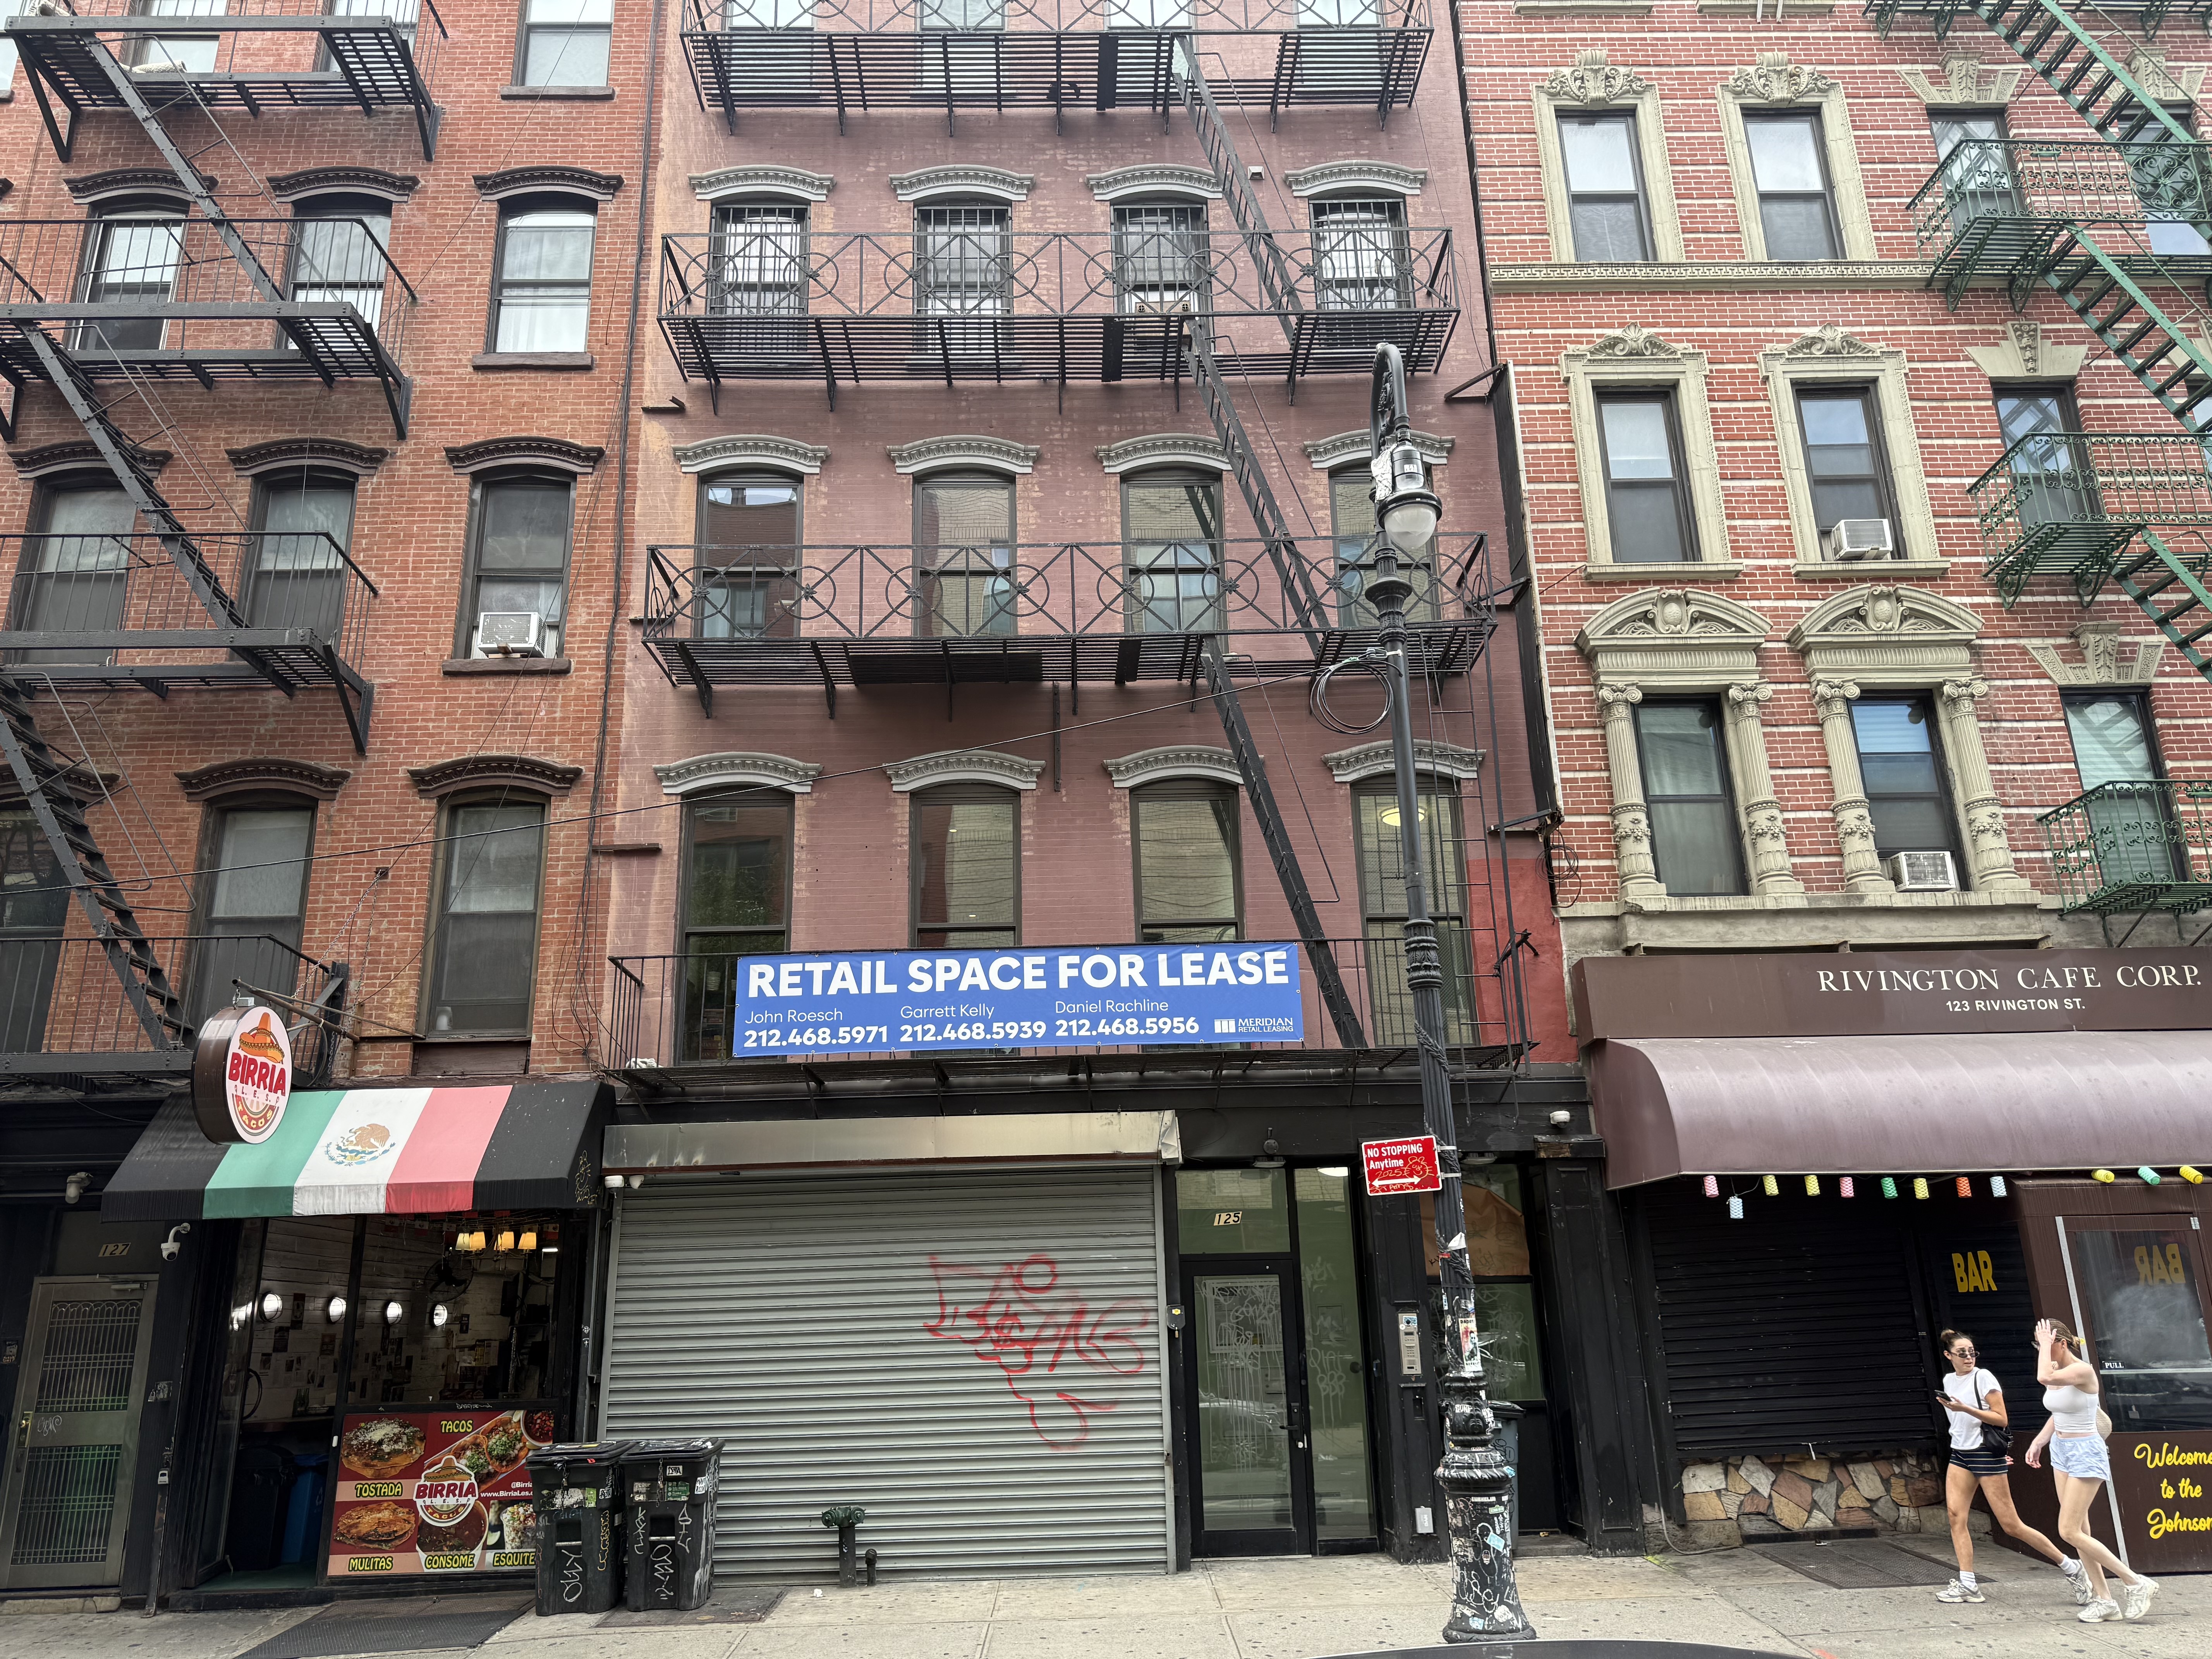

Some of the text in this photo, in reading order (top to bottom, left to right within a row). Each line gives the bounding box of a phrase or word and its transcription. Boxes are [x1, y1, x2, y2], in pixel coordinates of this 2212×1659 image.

[749, 951, 1289, 998] RETAIL SPACE FOR LEASE
[1817, 965, 2202, 991] RIVINGTON CAFE CORP.
[900, 1003, 994, 1019] Garrett Kelly
[1056, 999, 1168, 1013] Daniel Rachline
[1946, 998, 2085, 1012] 123 RIVINGTON ST.
[745, 1008, 843, 1024] John Roesch
[1238, 1017, 1293, 1027] MERIDIAN
[900, 1021, 1046, 1042] 212.468.5939
[1055, 1017, 1199, 1036] 212.468.5956
[744, 1025, 887, 1047] 212.468.5971
[228, 1052, 286, 1096] BIRRIA
[242, 1086, 271, 1102] L. E. S.
[238, 1101, 273, 1128] TACOS
[1367, 1143, 1423, 1158] NO STOPPING
[1370, 1158, 1404, 1171] Anytime
[1375, 1169, 1402, 1180] 2025
[1218, 1212, 1240, 1225] 125
[102, 1243, 130, 1256] 127
[1951, 1250, 1997, 1293] BAR
[440, 1420, 473, 1433] TACOS
[2134, 1443, 2212, 1468] Welcome
[356, 1483, 402, 1497] TOSTADA
[415, 1482, 477, 1499] BIRRIA
[2160, 1477, 2202, 1498] to the
[428, 1506, 464, 1519] TACOS
[349, 1558, 393, 1571] MULITAS
[426, 1555, 474, 1568] CONSOME
[493, 1553, 536, 1566] ESQUITE
